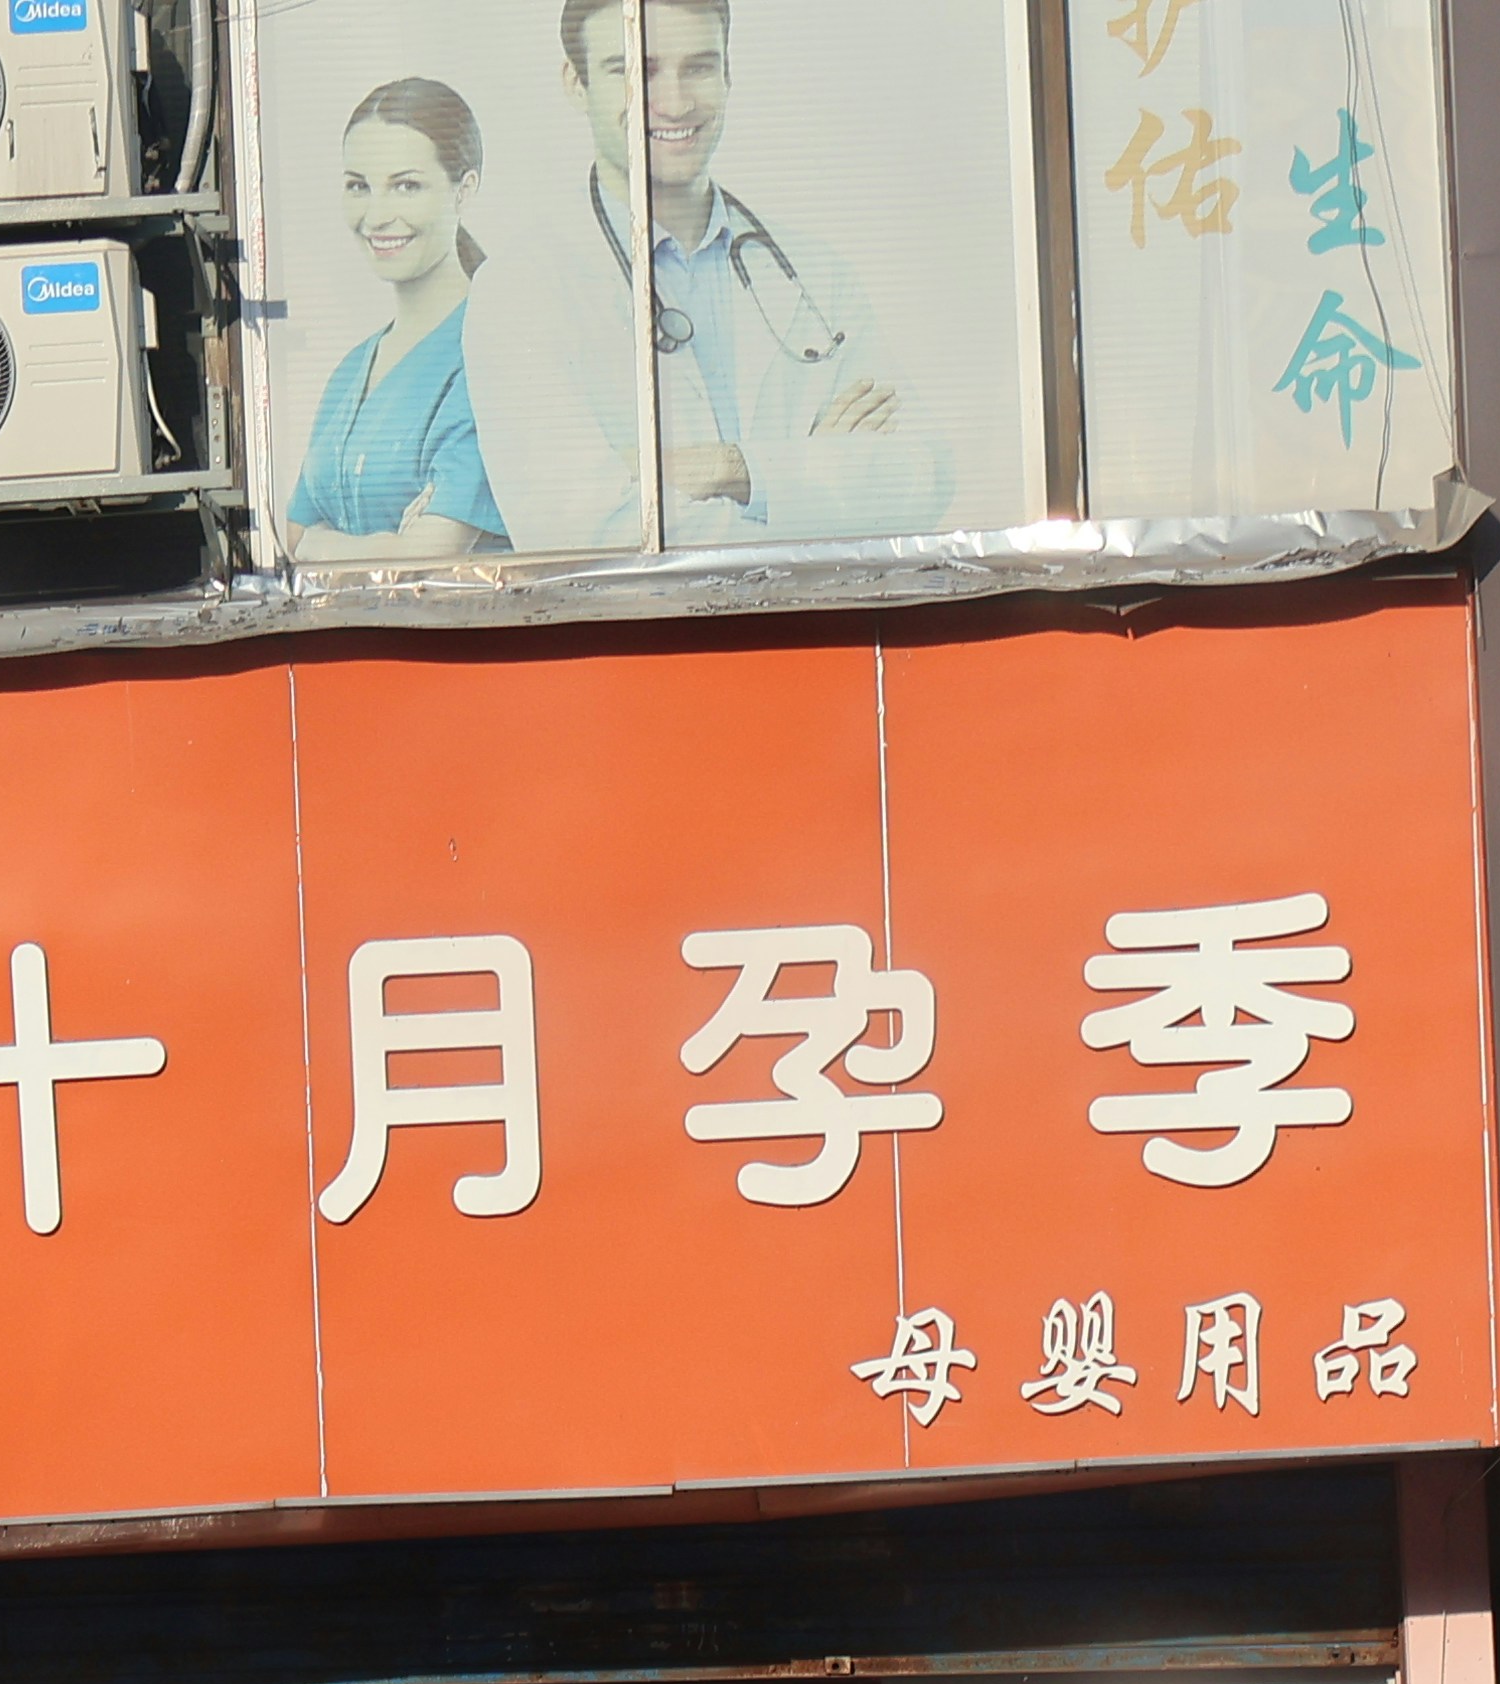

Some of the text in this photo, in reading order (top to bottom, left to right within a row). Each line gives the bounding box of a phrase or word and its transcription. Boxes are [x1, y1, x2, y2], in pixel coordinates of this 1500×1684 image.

[16, 0, 82, 20] Midea
[30, 280, 95, 301] Midea
[1271, 107, 1423, 451] 生命
[849, 1289, 1419, 1427] 母婴用品
